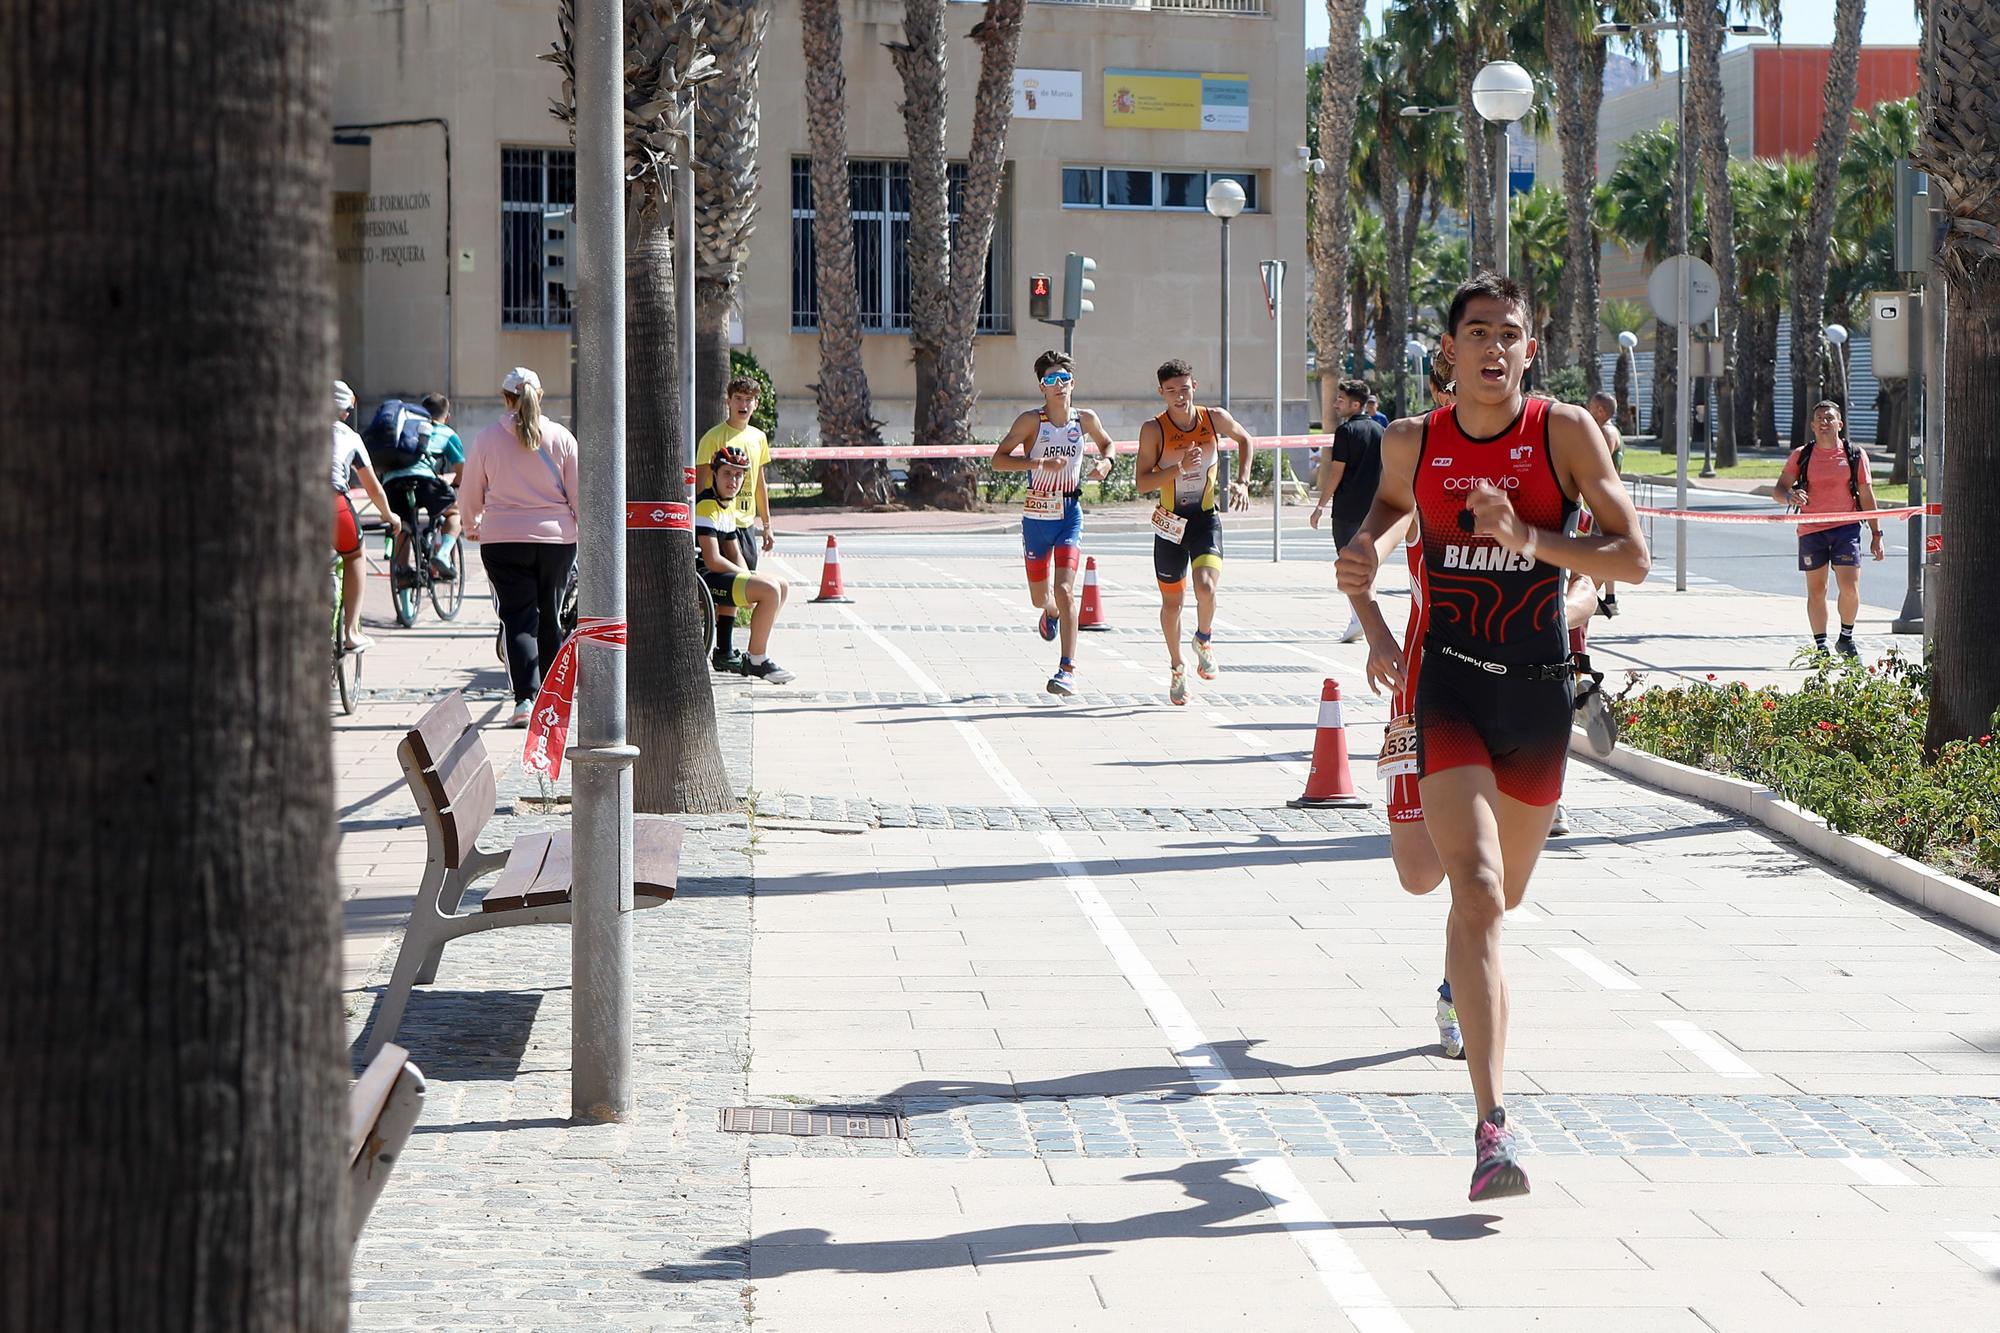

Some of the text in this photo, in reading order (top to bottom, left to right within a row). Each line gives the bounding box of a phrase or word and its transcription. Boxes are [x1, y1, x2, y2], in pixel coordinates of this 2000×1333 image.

[379, 189, 431, 211] FORMACIÓN
[382, 245, 425, 268] PESQUERA
[1043, 445, 1077, 458] ARENAS
[1024, 500, 1048, 510] 1204
[1443, 544, 1536, 572] BLANES
